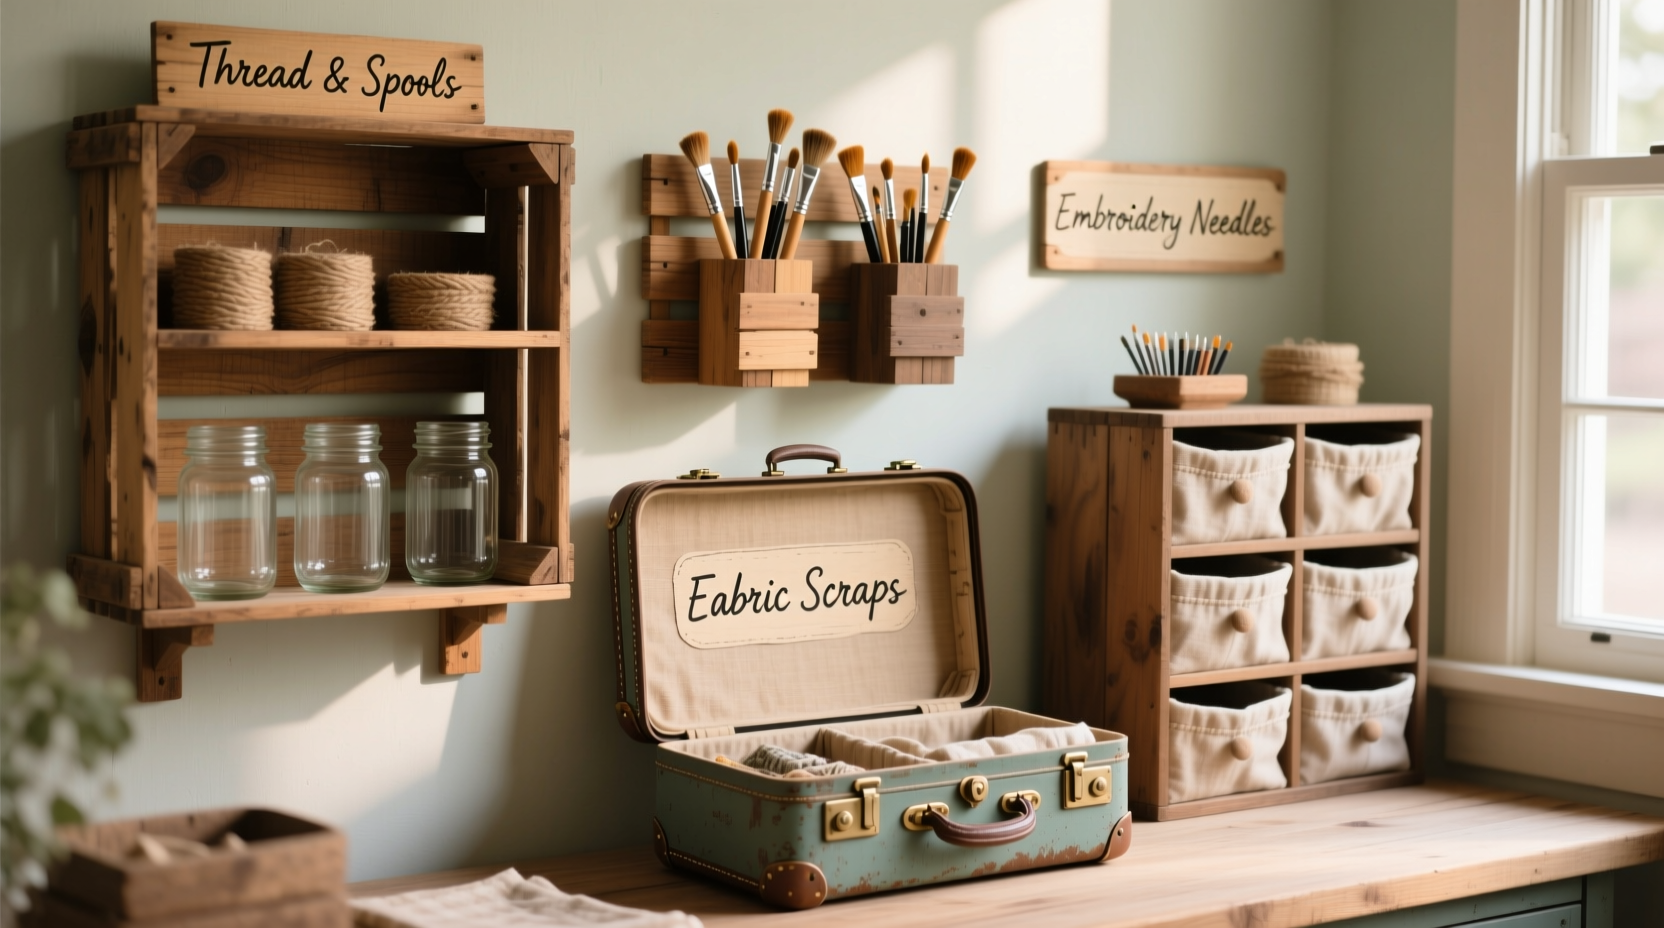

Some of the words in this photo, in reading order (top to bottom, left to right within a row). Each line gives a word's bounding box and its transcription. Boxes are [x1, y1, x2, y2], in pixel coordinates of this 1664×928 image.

[190, 40, 313, 90] Thread
[323, 56, 349, 93] &
[361, 54, 462, 113] Spools
[1055, 193, 1182, 250] Embroidery
[1190, 199, 1276, 237] Needles
[800, 566, 907, 622] Scraps
